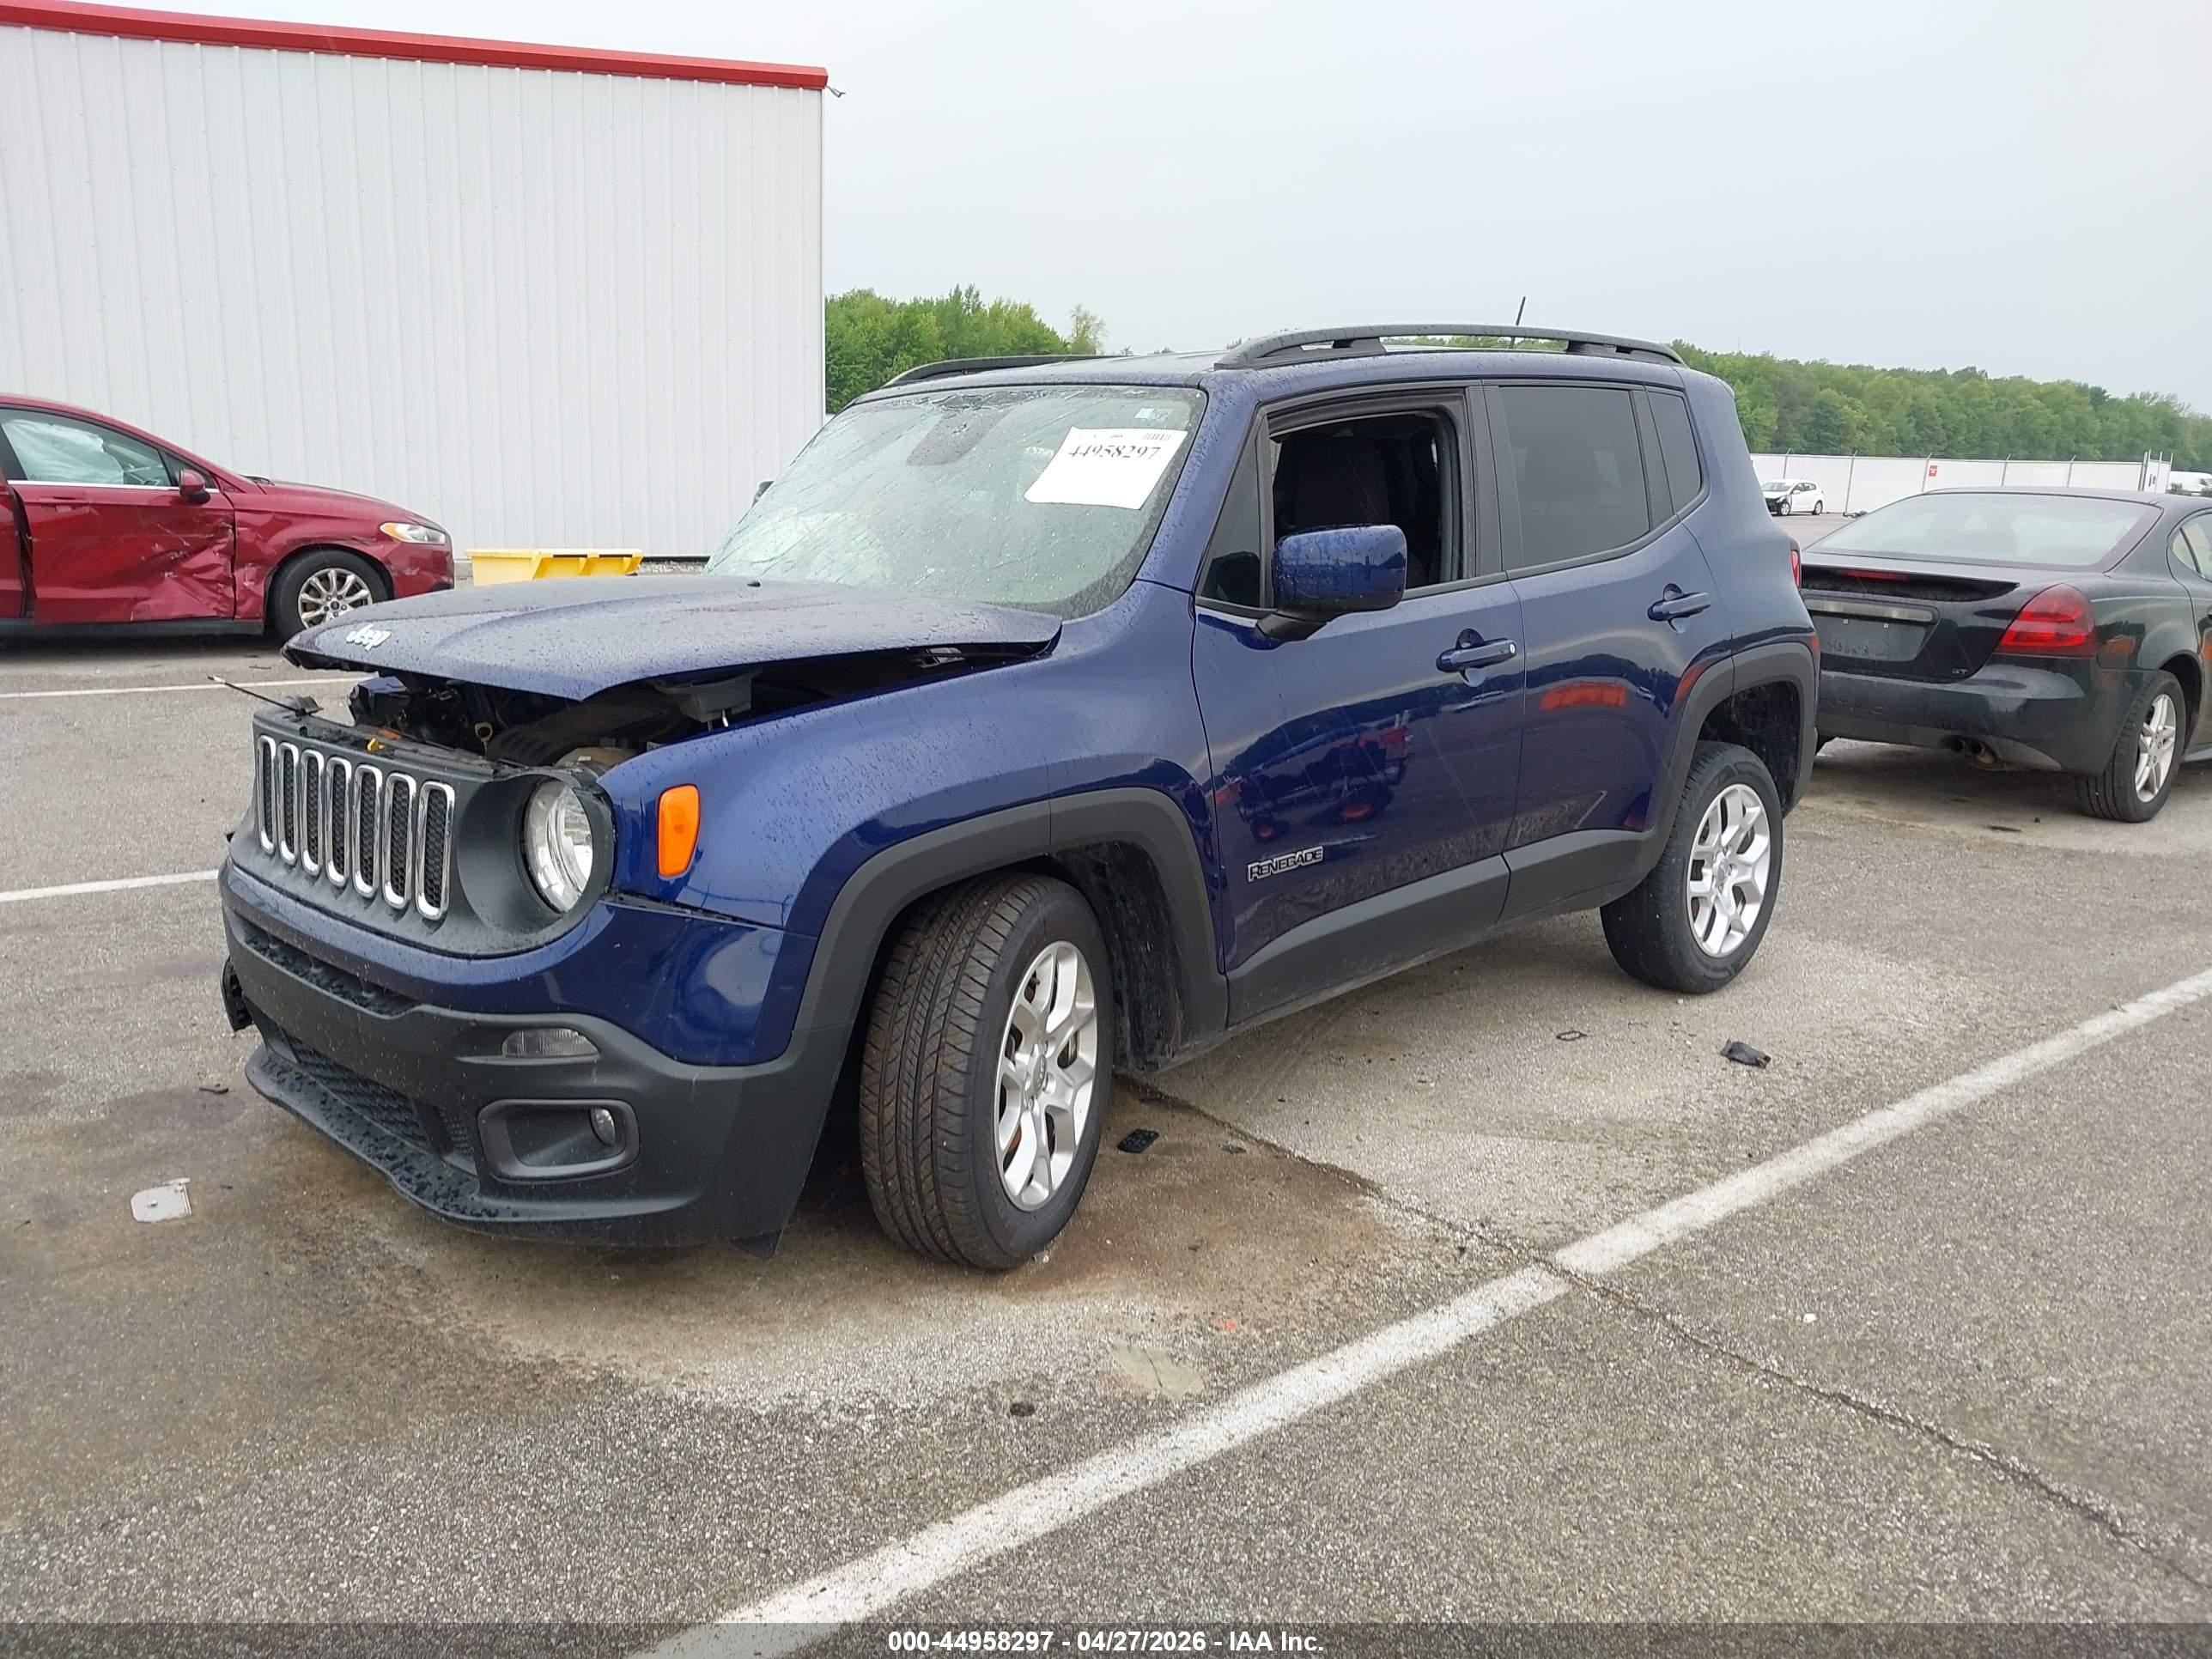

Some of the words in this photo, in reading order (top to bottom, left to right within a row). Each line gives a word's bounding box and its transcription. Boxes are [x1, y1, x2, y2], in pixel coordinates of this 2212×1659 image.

[1068, 444, 1161, 459] 44958297
[346, 623, 391, 651] Jeep
[1248, 846, 1323, 882] RENEGADE
